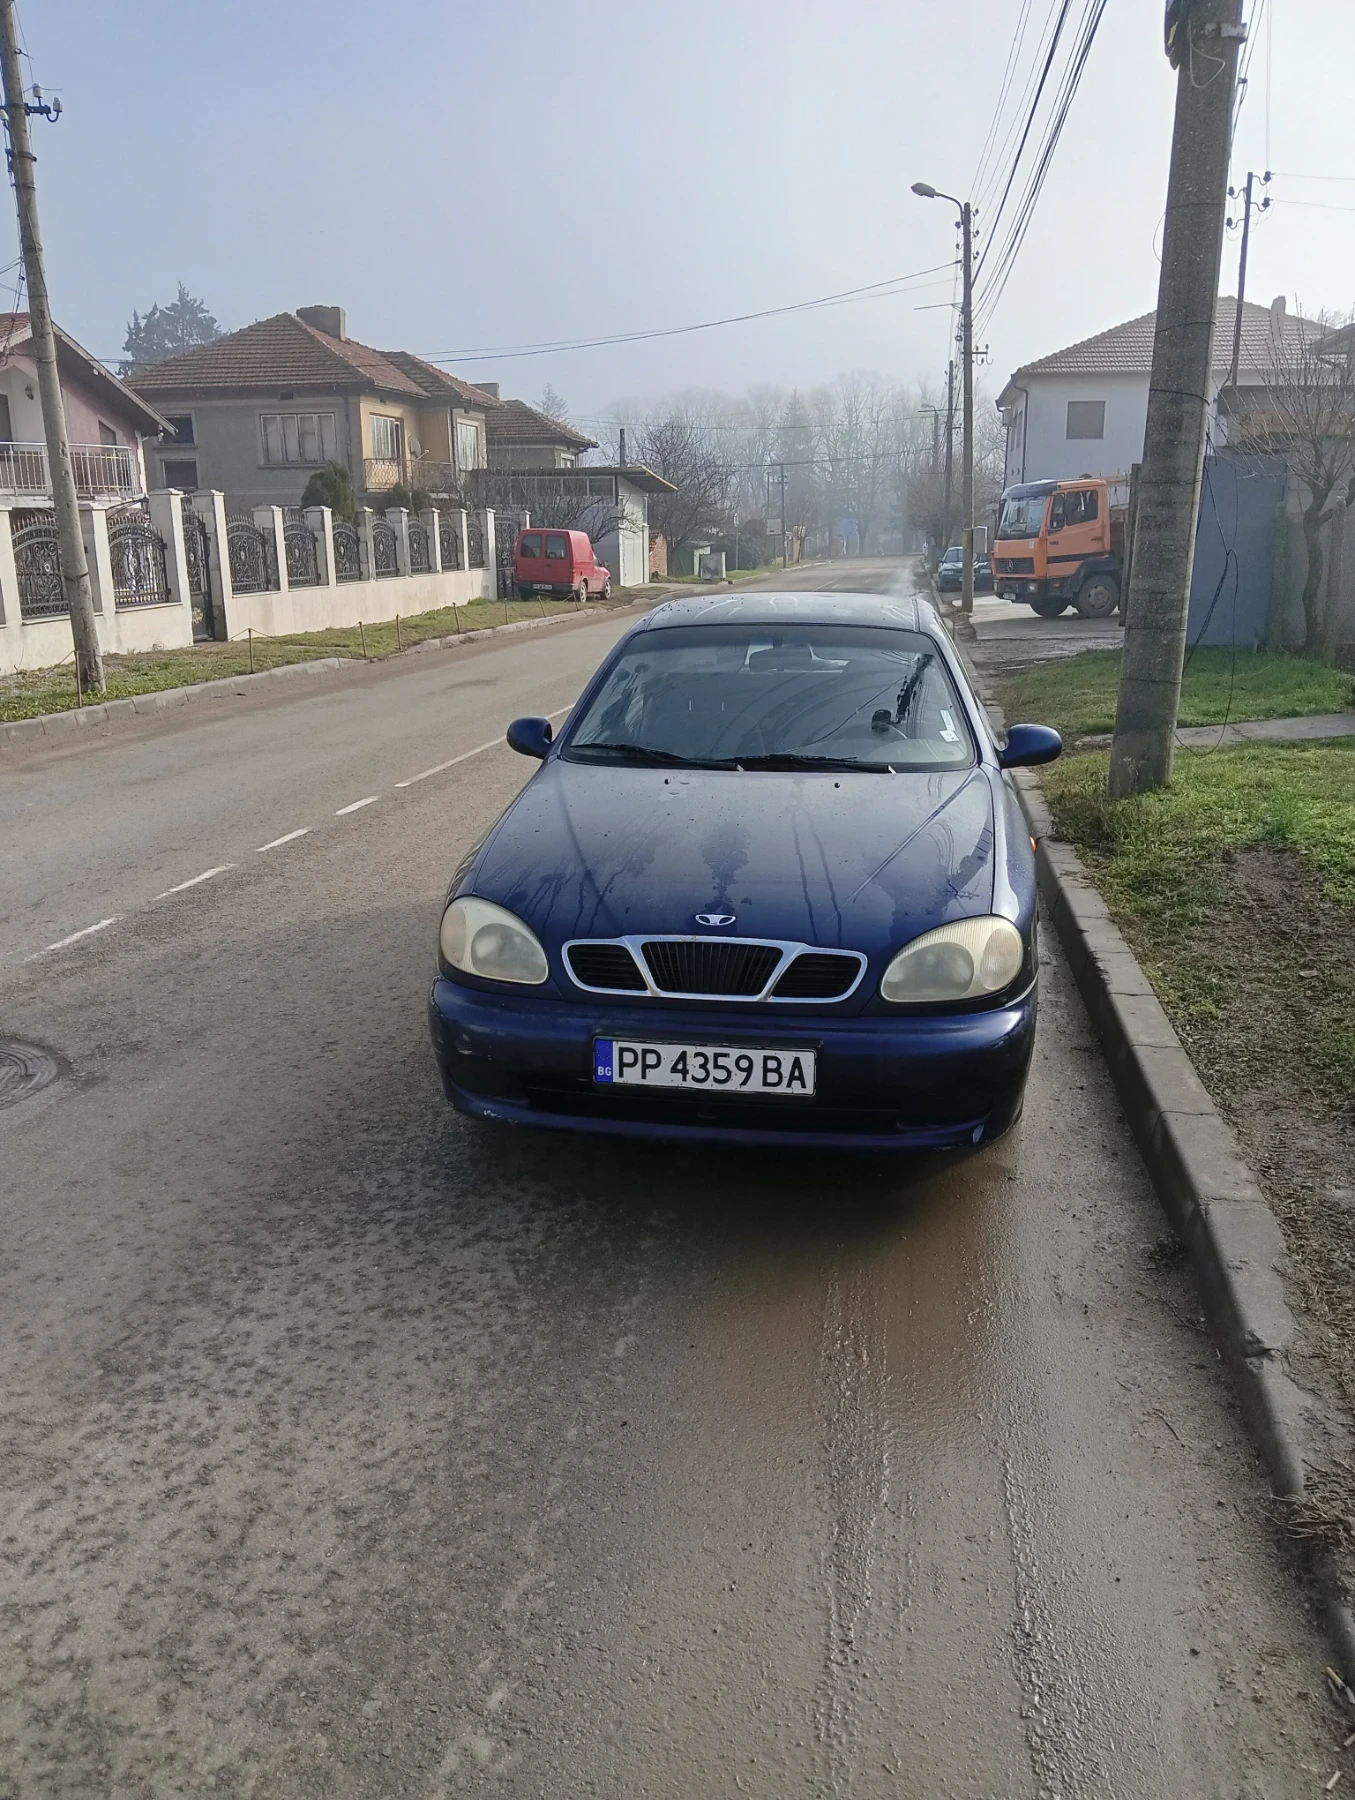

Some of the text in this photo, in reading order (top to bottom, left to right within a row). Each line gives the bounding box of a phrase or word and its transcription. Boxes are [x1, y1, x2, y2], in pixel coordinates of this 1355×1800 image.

[597, 1065, 612, 1077] BG
[618, 1046, 807, 1089] PP 4359 BA
